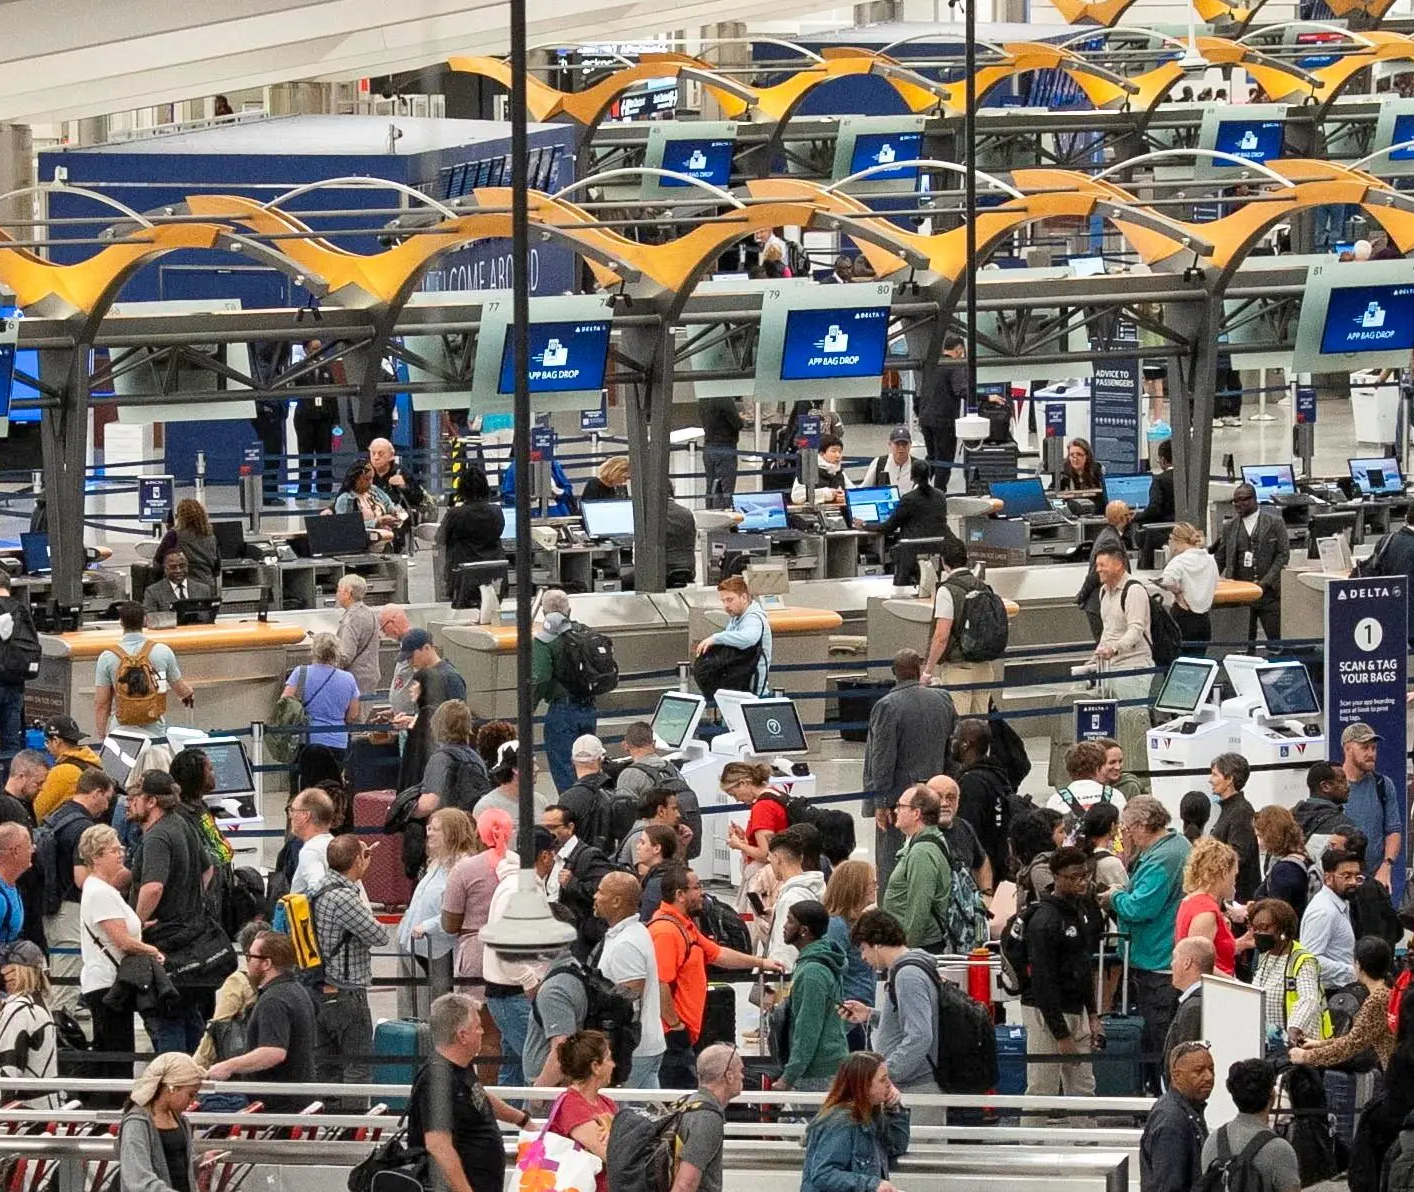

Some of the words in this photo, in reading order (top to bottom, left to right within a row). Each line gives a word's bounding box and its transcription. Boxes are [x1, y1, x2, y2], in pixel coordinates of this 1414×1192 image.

[1313, 266, 1323, 275] 81
[769, 289, 780, 299] 79
[877, 285, 889, 294] 80
[488, 303, 500, 311] 77
[1347, 332, 1361, 340] APP
[1361, 331, 1374, 340] BAG
[1375, 330, 1395, 339] DROP
[808, 357, 822, 366] APP
[823, 356, 838, 365] BAG
[839, 356, 860, 364] DROP
[542, 370, 557, 379] BAG
[558, 370, 579, 379] DROP
[1095, 370, 1119, 379] ADVICE
[1120, 371, 1129, 379] TO
[1095, 379, 1134, 387] PASSENGERS
[1350, 588, 1389, 599] DELTA
[1364, 624, 1372, 644] 1
[1339, 661, 1367, 672] SCAN
[1368, 660, 1377, 670] &
[1377, 659, 1397, 669] TAG
[1341, 672, 1368, 684] YOUR
[1370, 671, 1396, 682] BAGS
